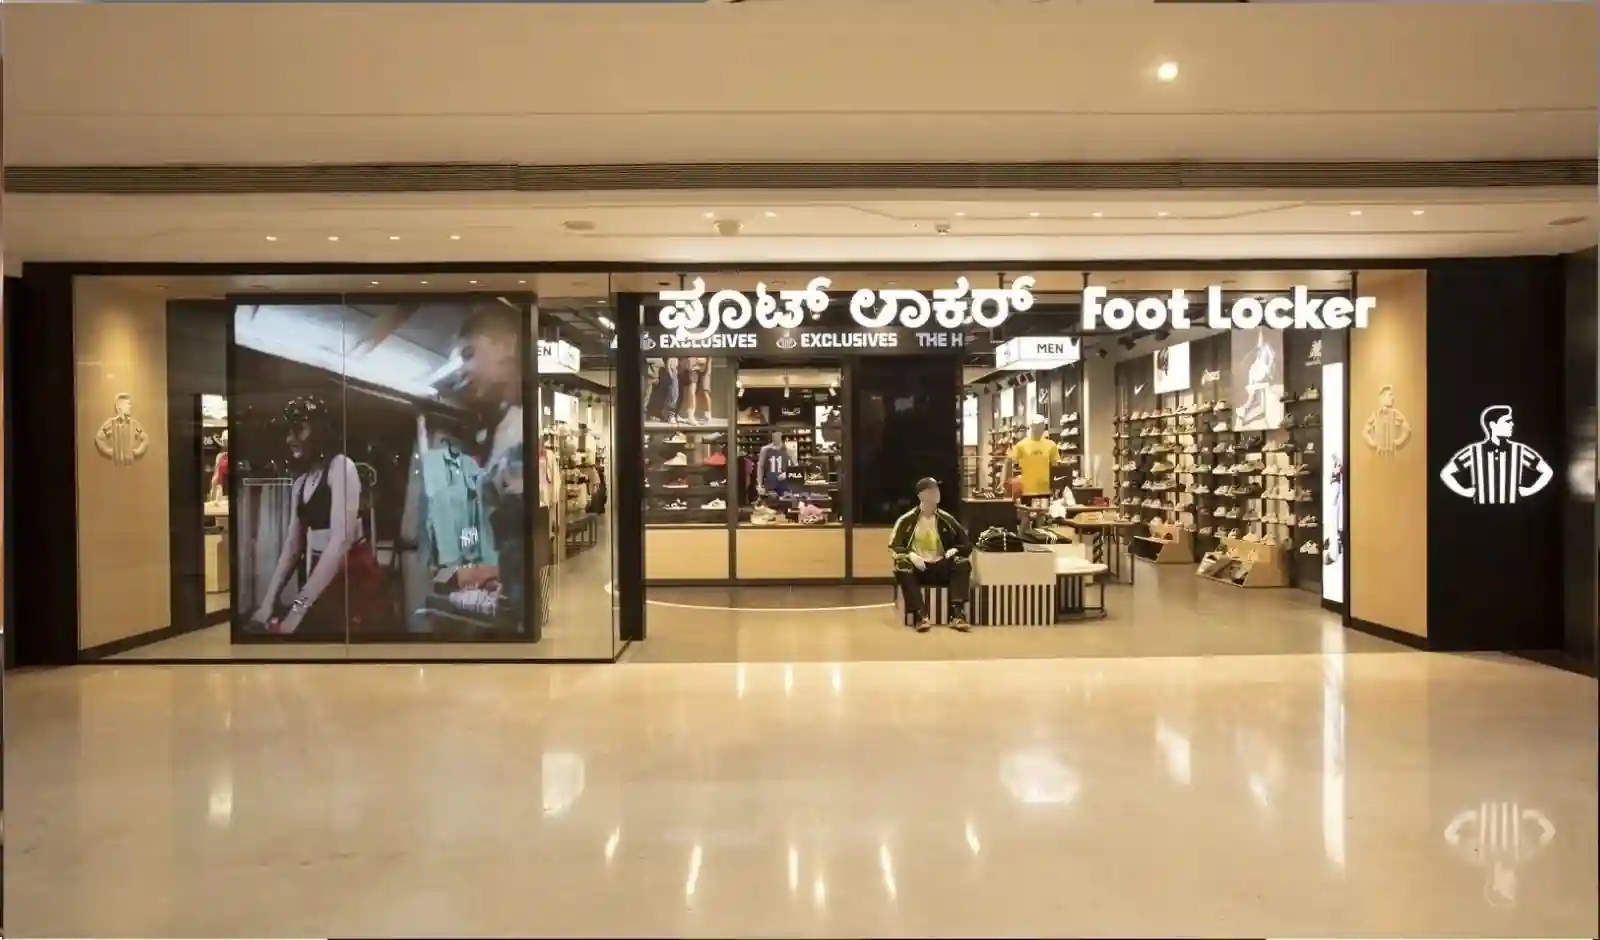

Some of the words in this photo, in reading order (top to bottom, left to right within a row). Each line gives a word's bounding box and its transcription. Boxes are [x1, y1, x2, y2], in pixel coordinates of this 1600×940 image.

[849, 275, 1037, 329] ಲಾಕರ್
[1083, 285, 1191, 330] Foot
[1207, 285, 1376, 330] Locker
[800, 333, 898, 348] EXCLUSIVES
[916, 333, 947, 347] THE
[1037, 343, 1064, 354] MEN
[768, 455, 783, 473] 11
